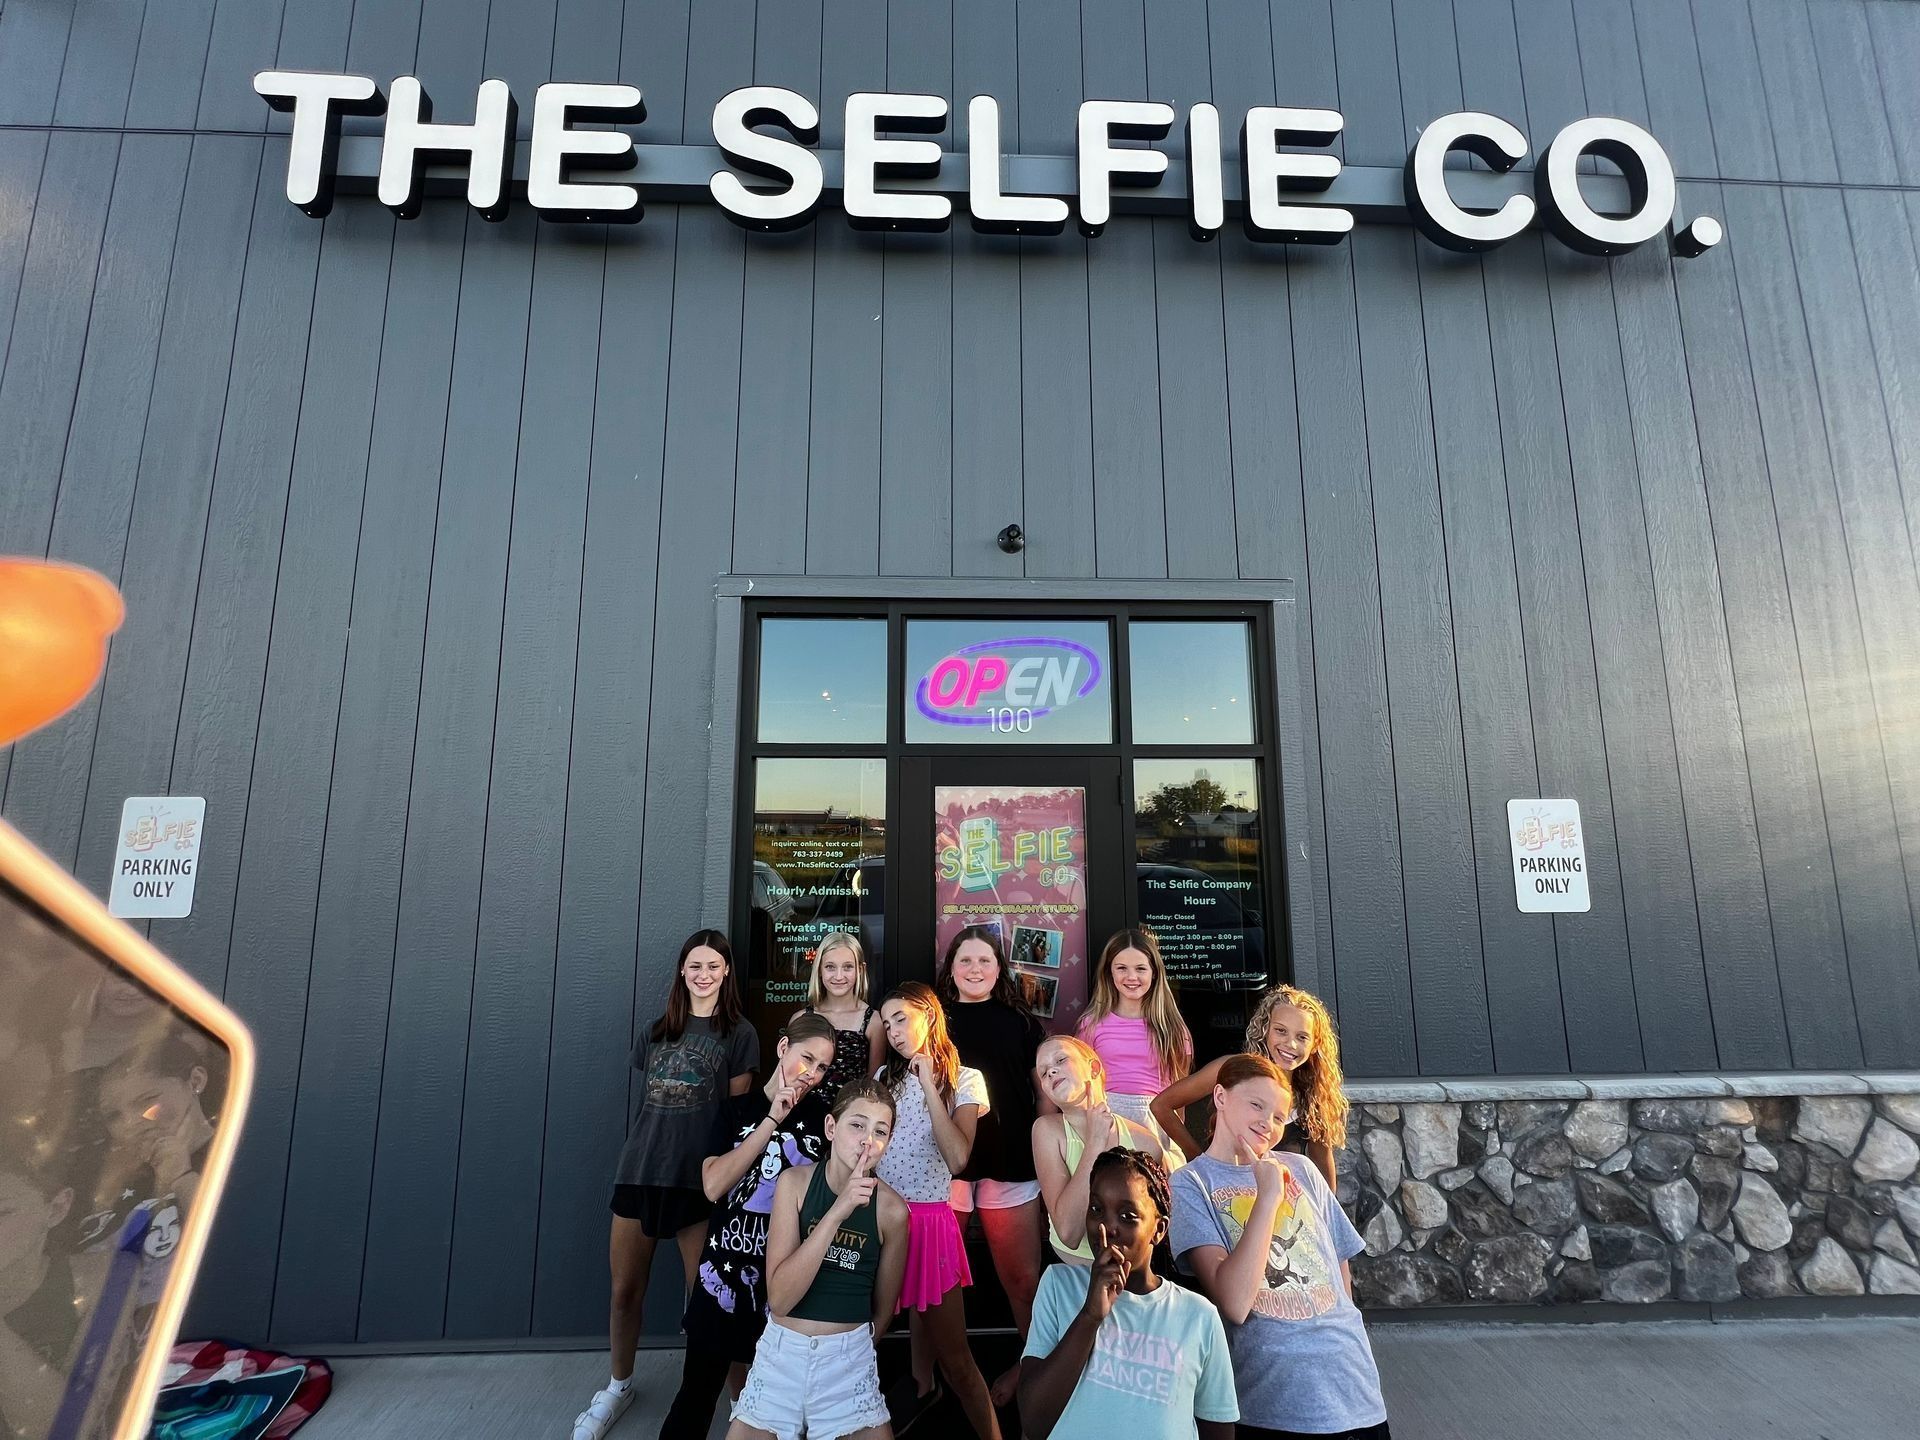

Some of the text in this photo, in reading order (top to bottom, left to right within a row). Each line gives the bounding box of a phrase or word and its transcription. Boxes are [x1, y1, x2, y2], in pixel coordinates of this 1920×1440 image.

[253, 71, 1722, 250] THE SELFIE CO.
[927, 656, 1080, 708] OPEN
[987, 707, 1032, 733] 100
[125, 820, 197, 848] SELFIE
[966, 828, 984, 840] THE
[1516, 822, 1577, 847] SELFIE
[940, 826, 1075, 880] SELFIE
[121, 859, 192, 875] PARKING
[1519, 857, 1582, 873] PARKING
[133, 882, 175, 898] ONLY
[766, 885, 806, 897] Hourly
[1146, 880, 1252, 890] The Selfie Company
[1535, 878, 1570, 894] ONLY
[1184, 896, 1216, 905] Hours
[943, 904, 1079, 914] SELF-PHOTOGRAPHY STUDIO
[774, 922, 860, 933] Private Parties
[766, 980, 810, 990] Conten
[765, 992, 810, 1002] Record
[730, 1215, 772, 1239] OLIV
[720, 1226, 764, 1256] RODR
[1253, 1288, 1313, 1320] ATIONAL
